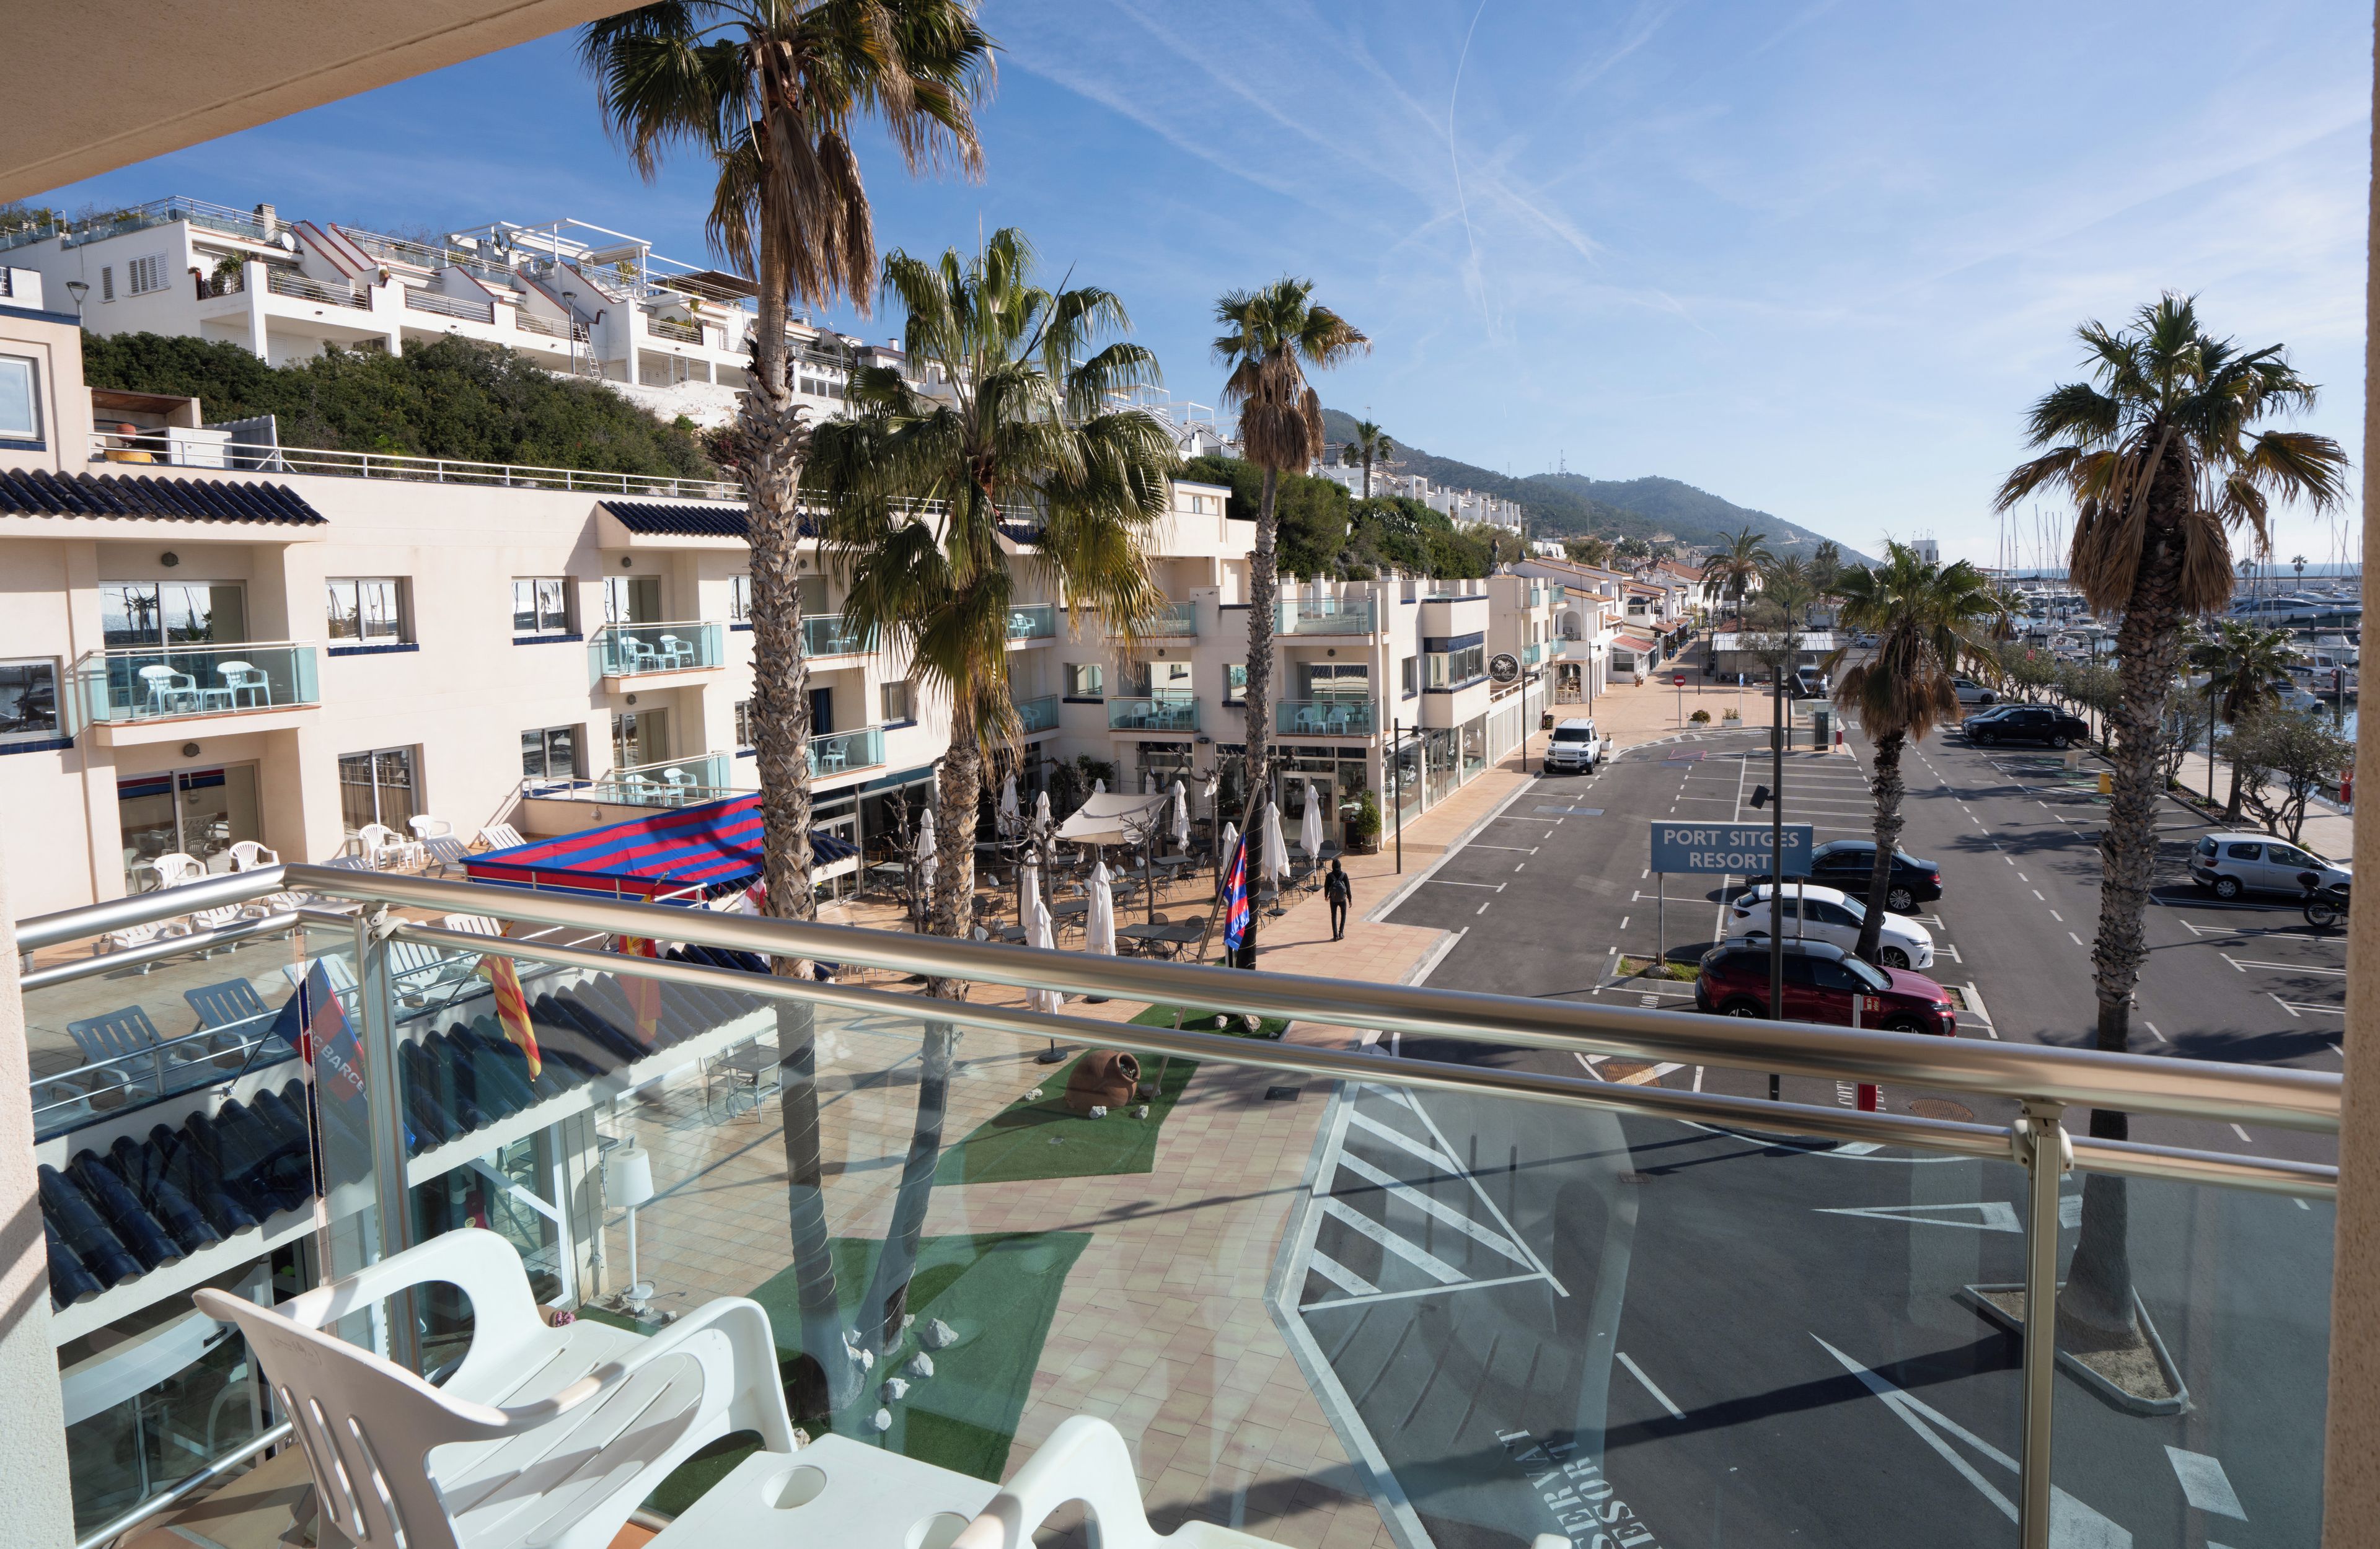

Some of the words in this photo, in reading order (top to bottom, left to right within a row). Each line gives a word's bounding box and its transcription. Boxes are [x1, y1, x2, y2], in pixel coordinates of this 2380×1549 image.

[1492, 655, 1515, 664] Restaurant
[1664, 829, 1721, 846] PORT
[1729, 831, 1799, 847] SITGES
[1690, 853, 1773, 869] RESORT
